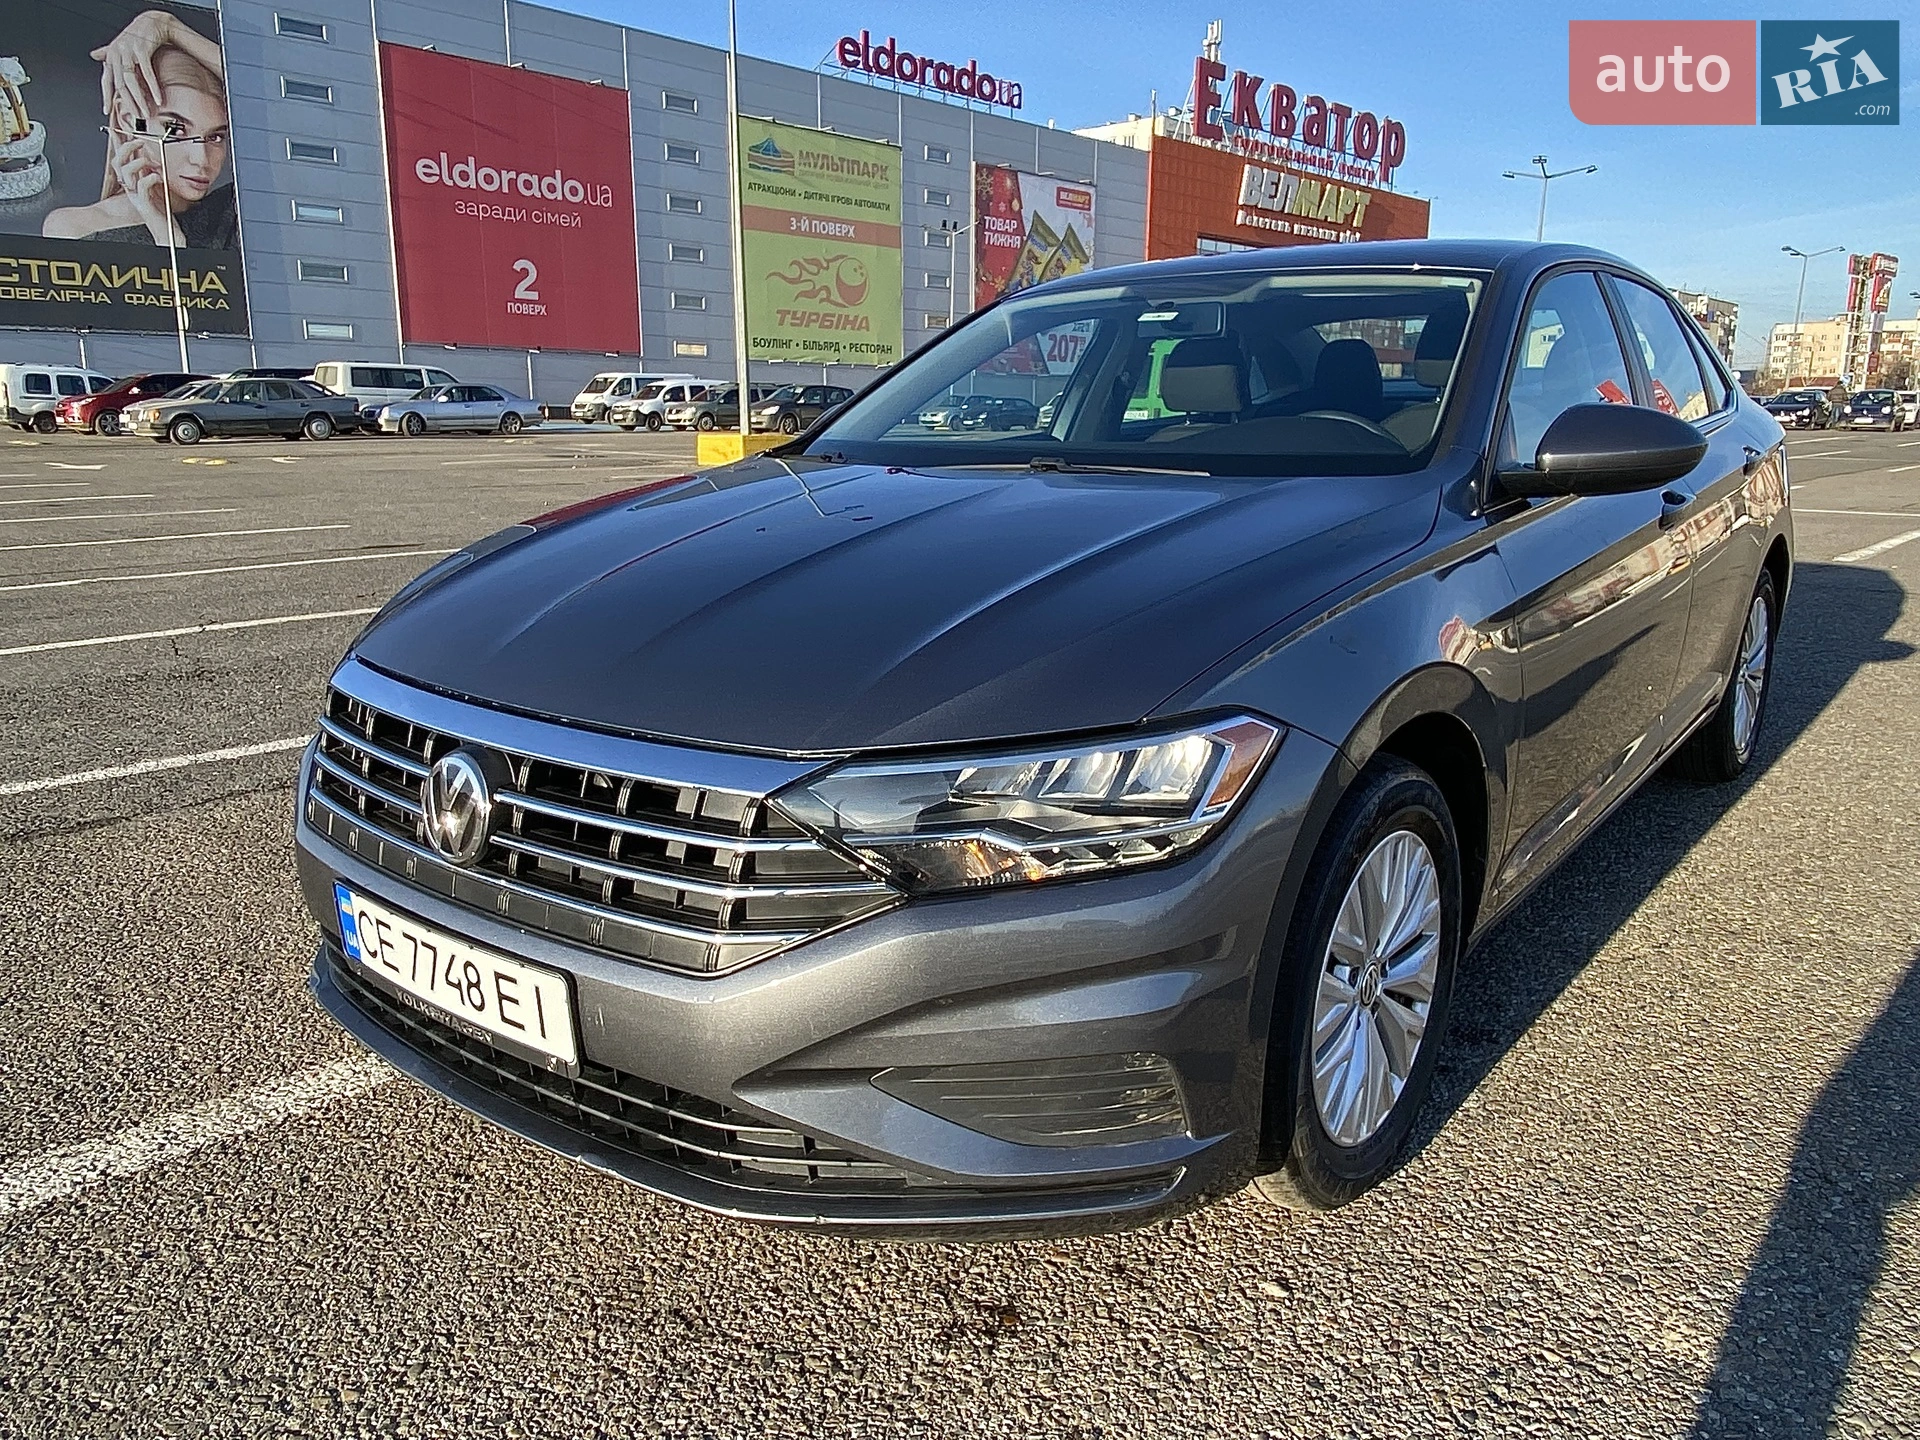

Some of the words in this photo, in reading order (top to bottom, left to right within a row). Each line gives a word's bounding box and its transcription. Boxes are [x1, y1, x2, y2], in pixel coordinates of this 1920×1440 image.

[415, 151, 613, 208] eldorado.ua
[1237, 163, 1372, 228] ВЕЛМАРТ
[454, 200, 527, 223] заради
[531, 206, 582, 229] сімей
[983, 215, 1017, 232] ТОВАР
[790, 217, 809, 232] 3-Й
[812, 220, 856, 238] ПОВЕРХ
[983, 231, 1021, 249] ТИЖНЯ
[512, 258, 539, 300] 2
[507, 302, 547, 316] ПОВЕРХ
[776, 309, 871, 332] ТУРБІНА
[752, 337, 793, 350] БОУЛІНГ
[802, 340, 841, 354] БІЛЬЯРД
[849, 343, 893, 355] РЕСТОРАН
[1046, 333, 1079, 362] 207
